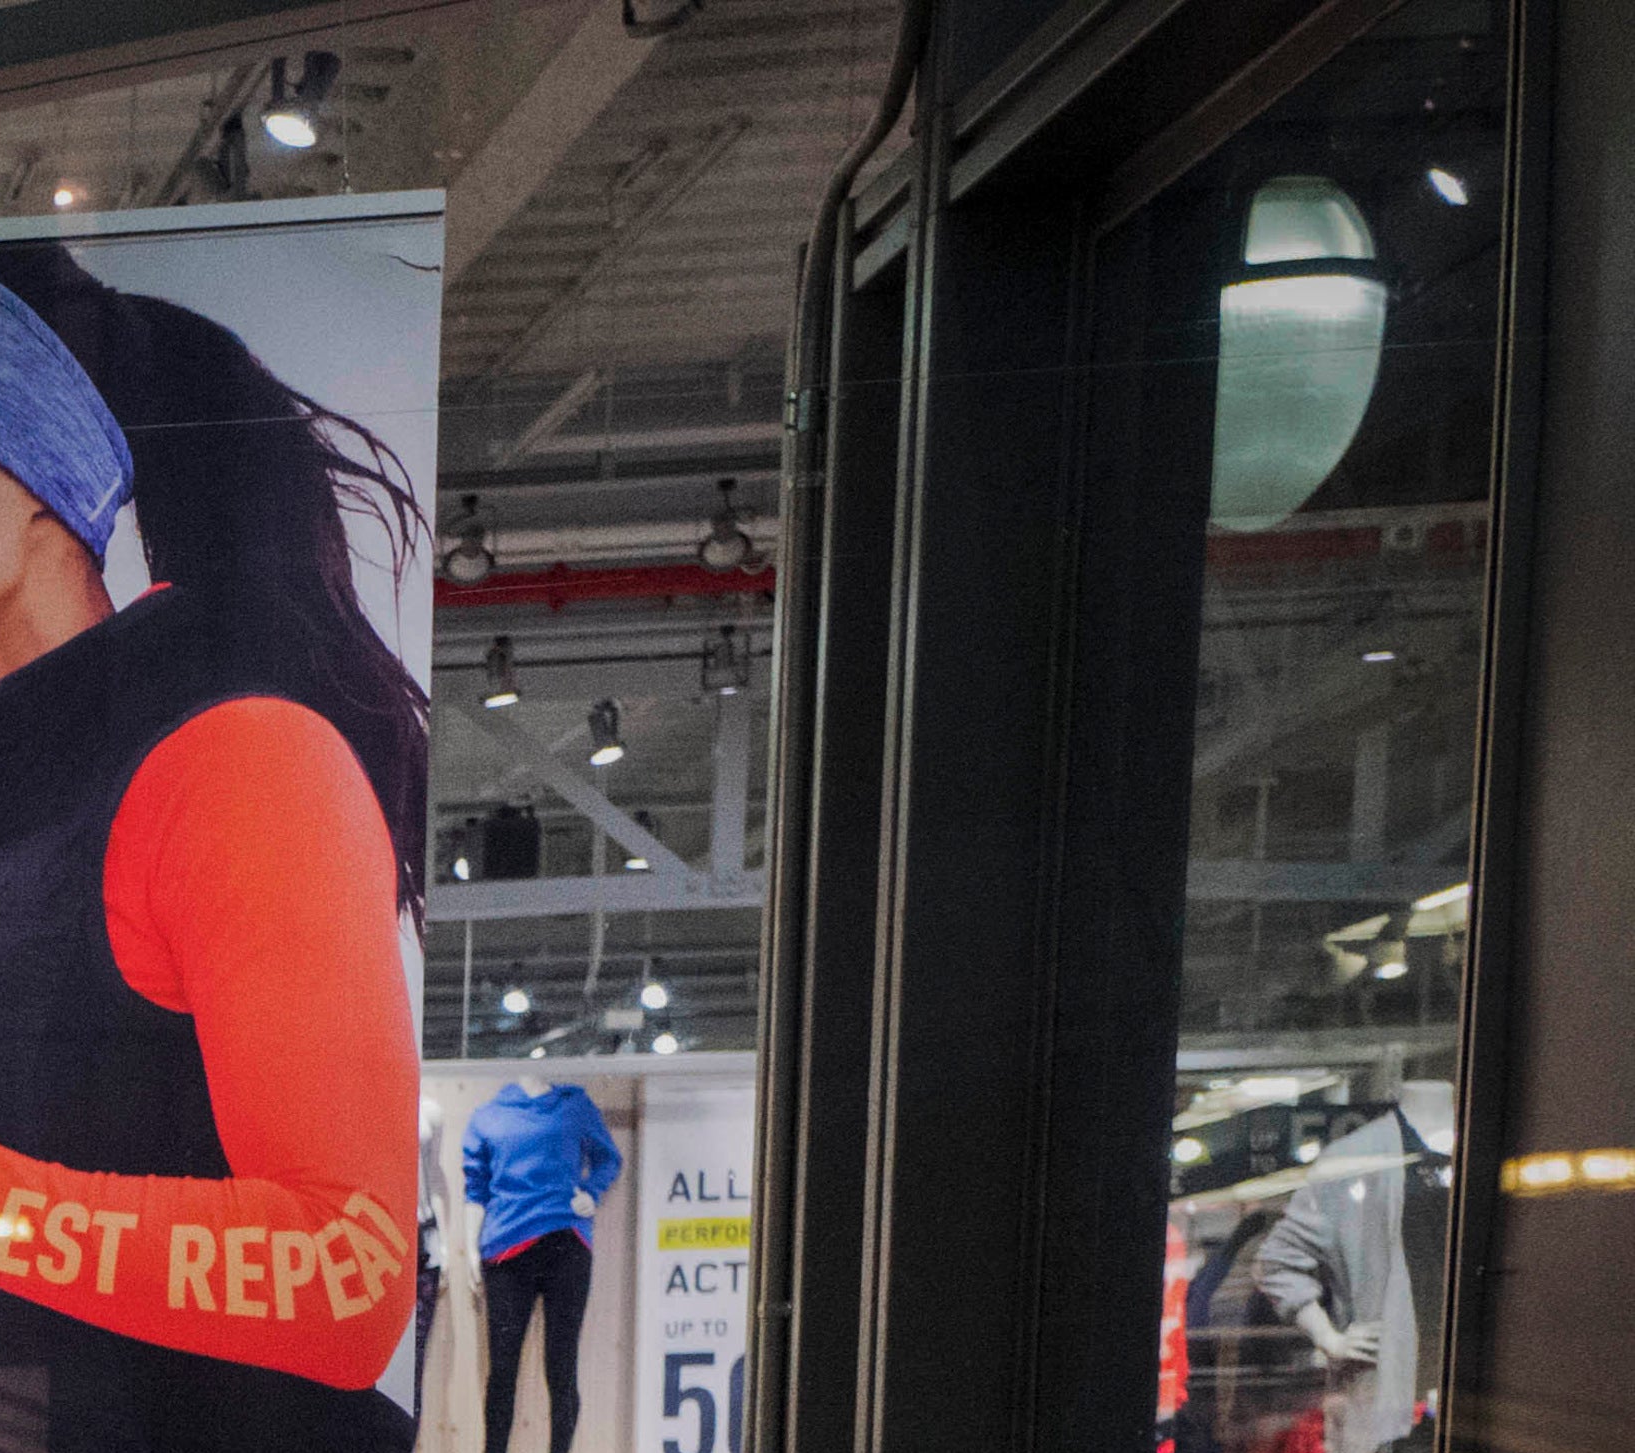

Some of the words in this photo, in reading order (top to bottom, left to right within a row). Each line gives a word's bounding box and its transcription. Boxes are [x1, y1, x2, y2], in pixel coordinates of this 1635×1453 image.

[668, 1170, 749, 1202] ALL
[665, 1320, 692, 1338] UP
[703, 1320, 727, 1336] TO
